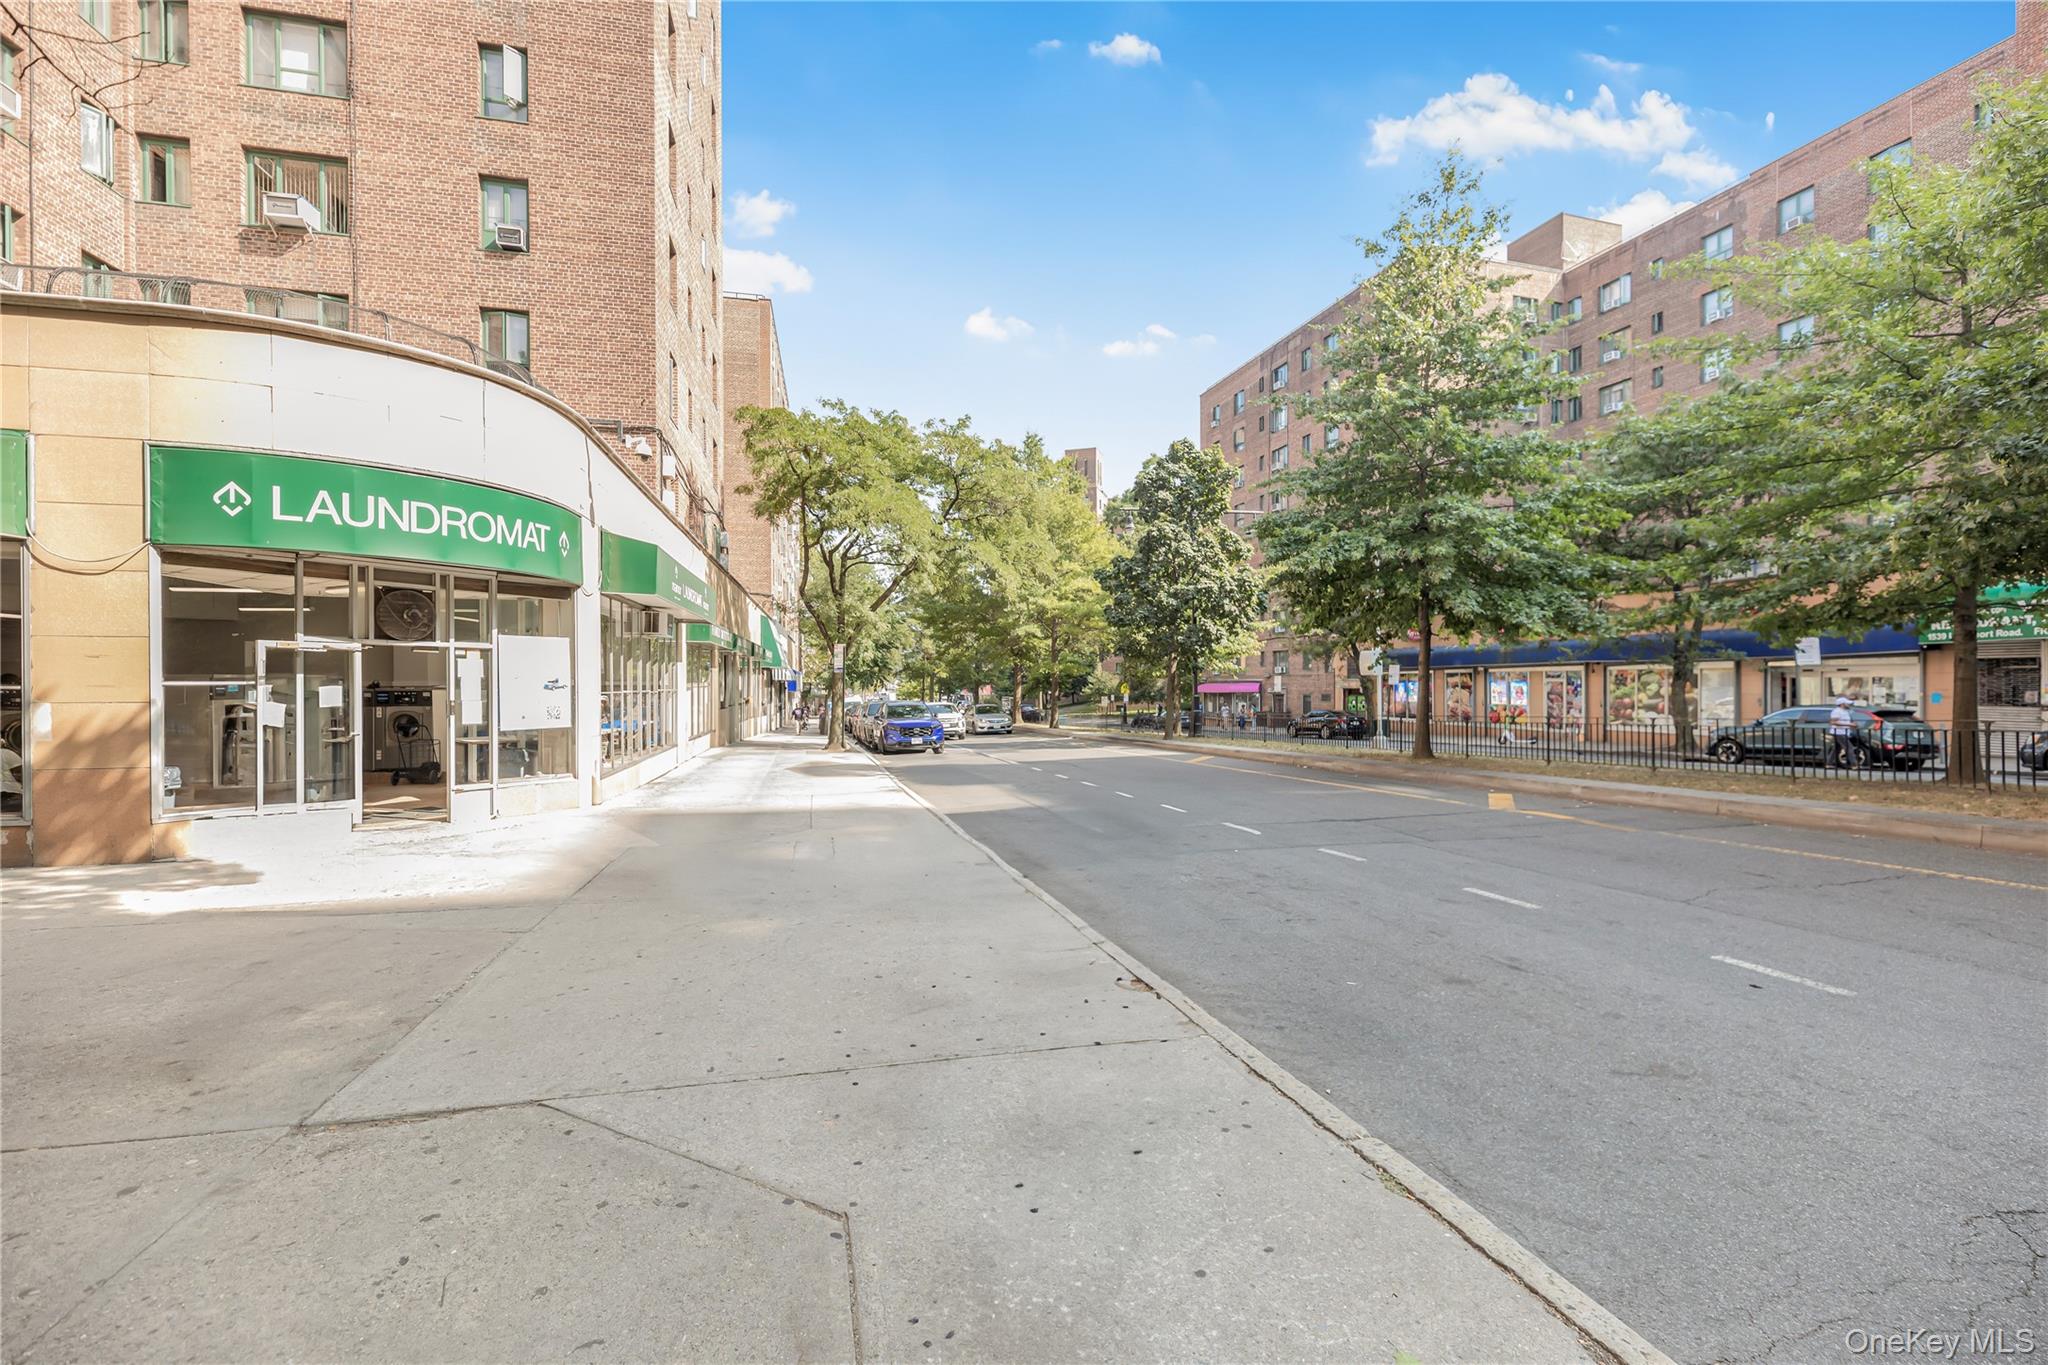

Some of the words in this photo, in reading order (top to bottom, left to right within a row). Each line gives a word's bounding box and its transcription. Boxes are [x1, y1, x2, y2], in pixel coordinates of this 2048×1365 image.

[271, 485, 551, 552] LAUNDROMAT
[1927, 632, 1947, 641] 1539
[1995, 628, 2023, 638] Road.
